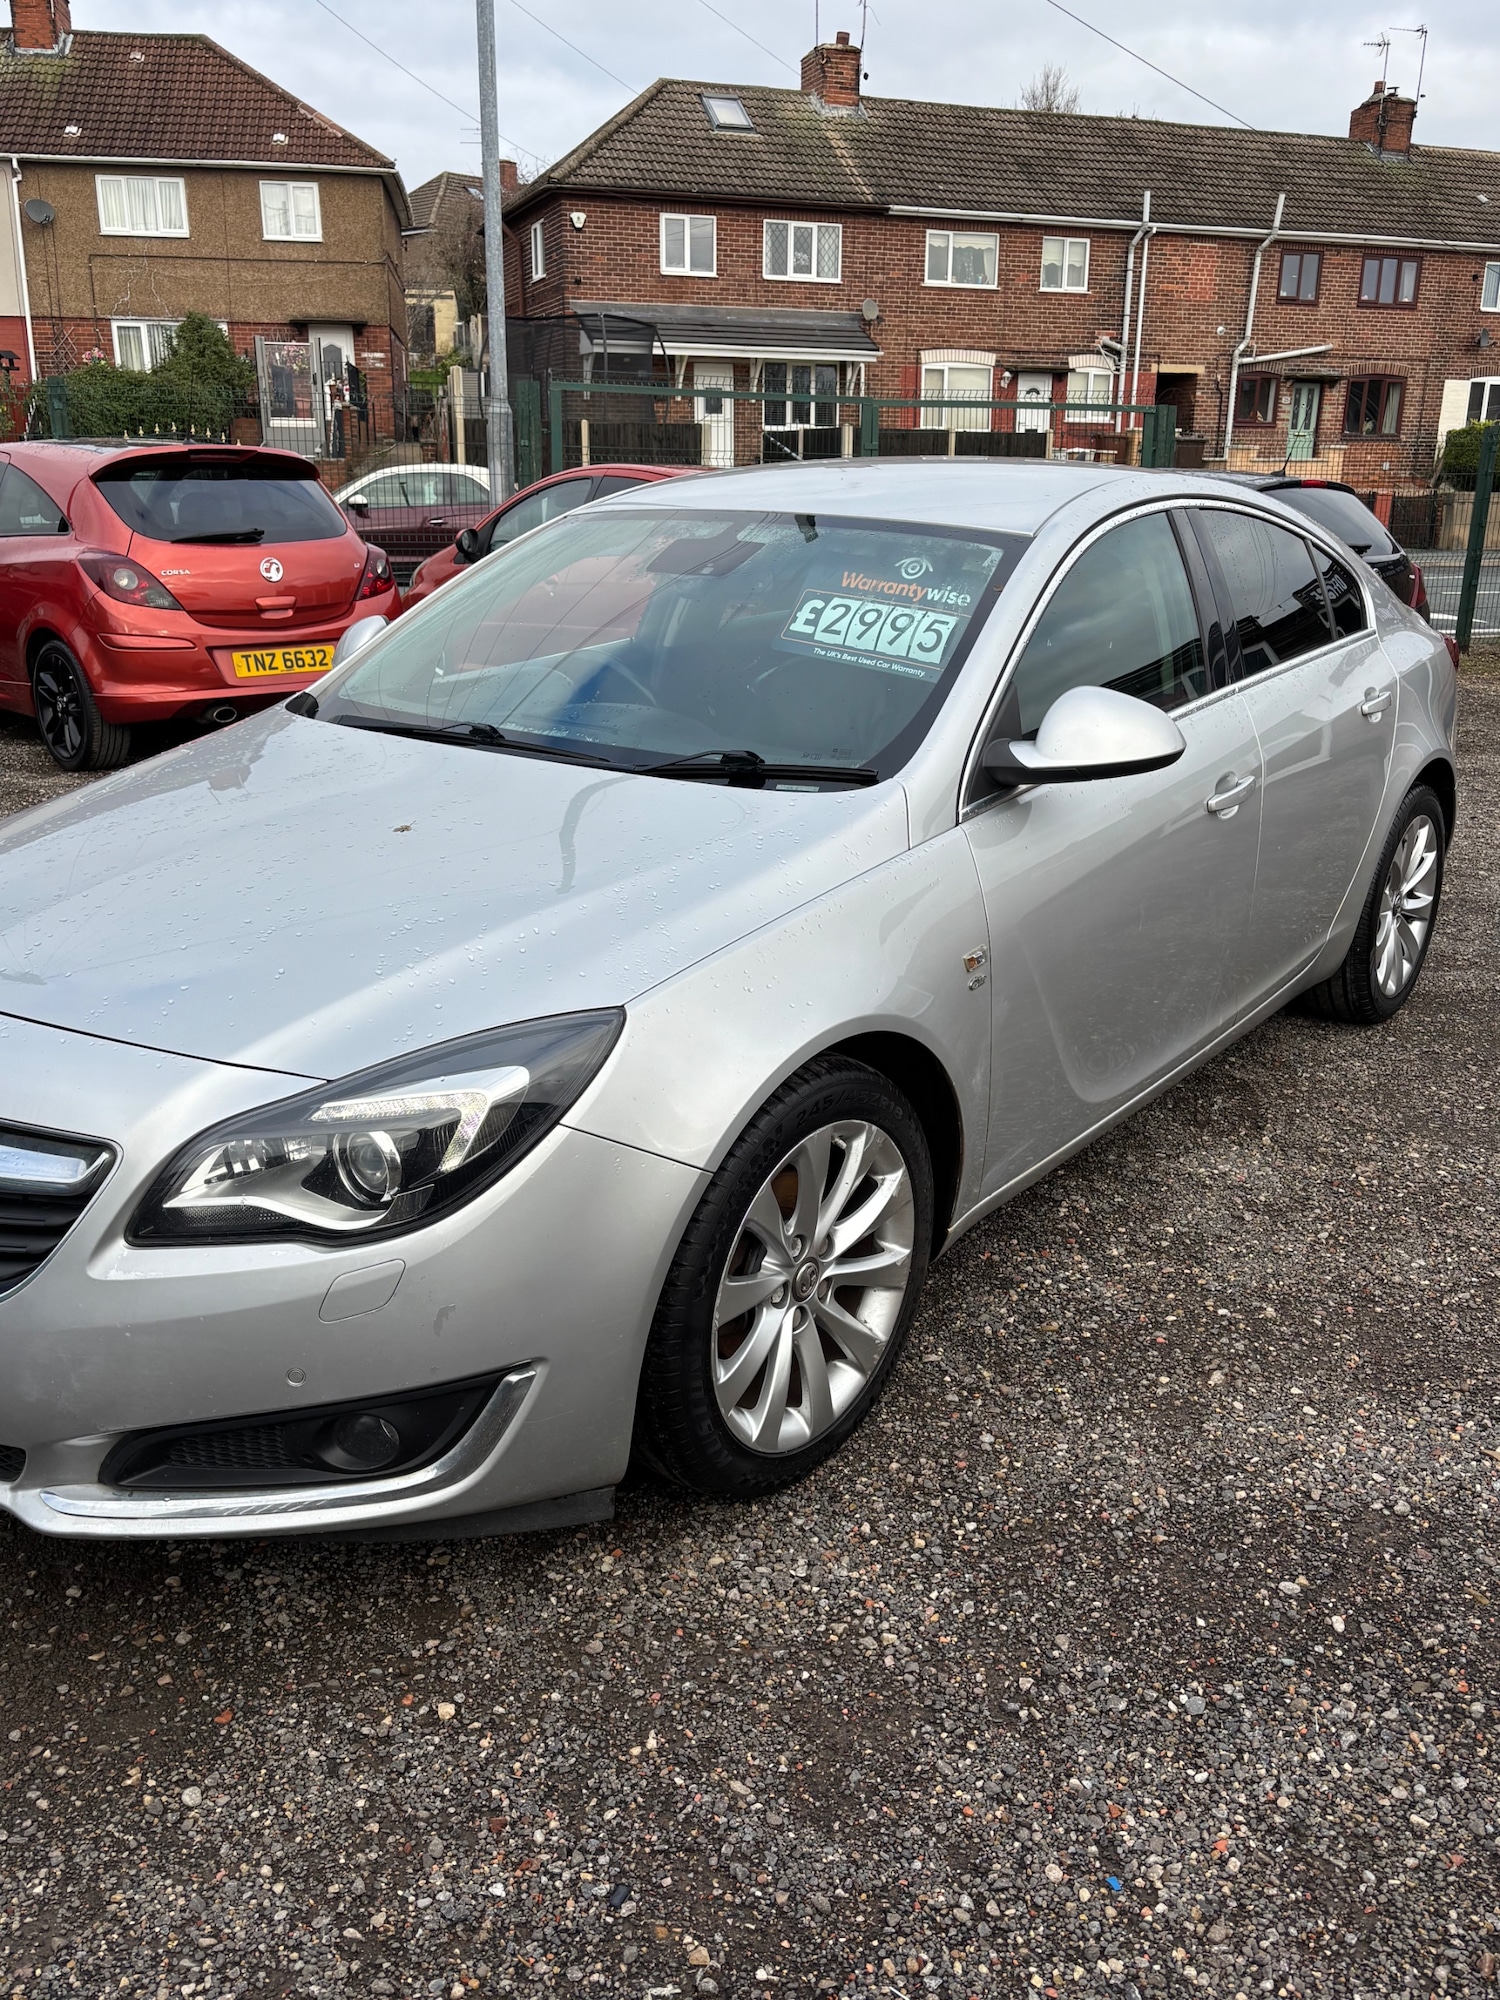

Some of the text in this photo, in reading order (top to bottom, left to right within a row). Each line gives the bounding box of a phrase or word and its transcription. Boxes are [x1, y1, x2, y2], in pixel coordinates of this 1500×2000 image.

[841, 570, 971, 607] Warrantywise
[789, 599, 952, 656] £2995
[241, 649, 329, 674] TNZ 6632
[813, 647, 826, 656] The
[826, 650, 842, 658] UK's
[842, 653, 858, 662] Best
[858, 656, 876, 666] Used
[876, 661, 891, 669] Car
